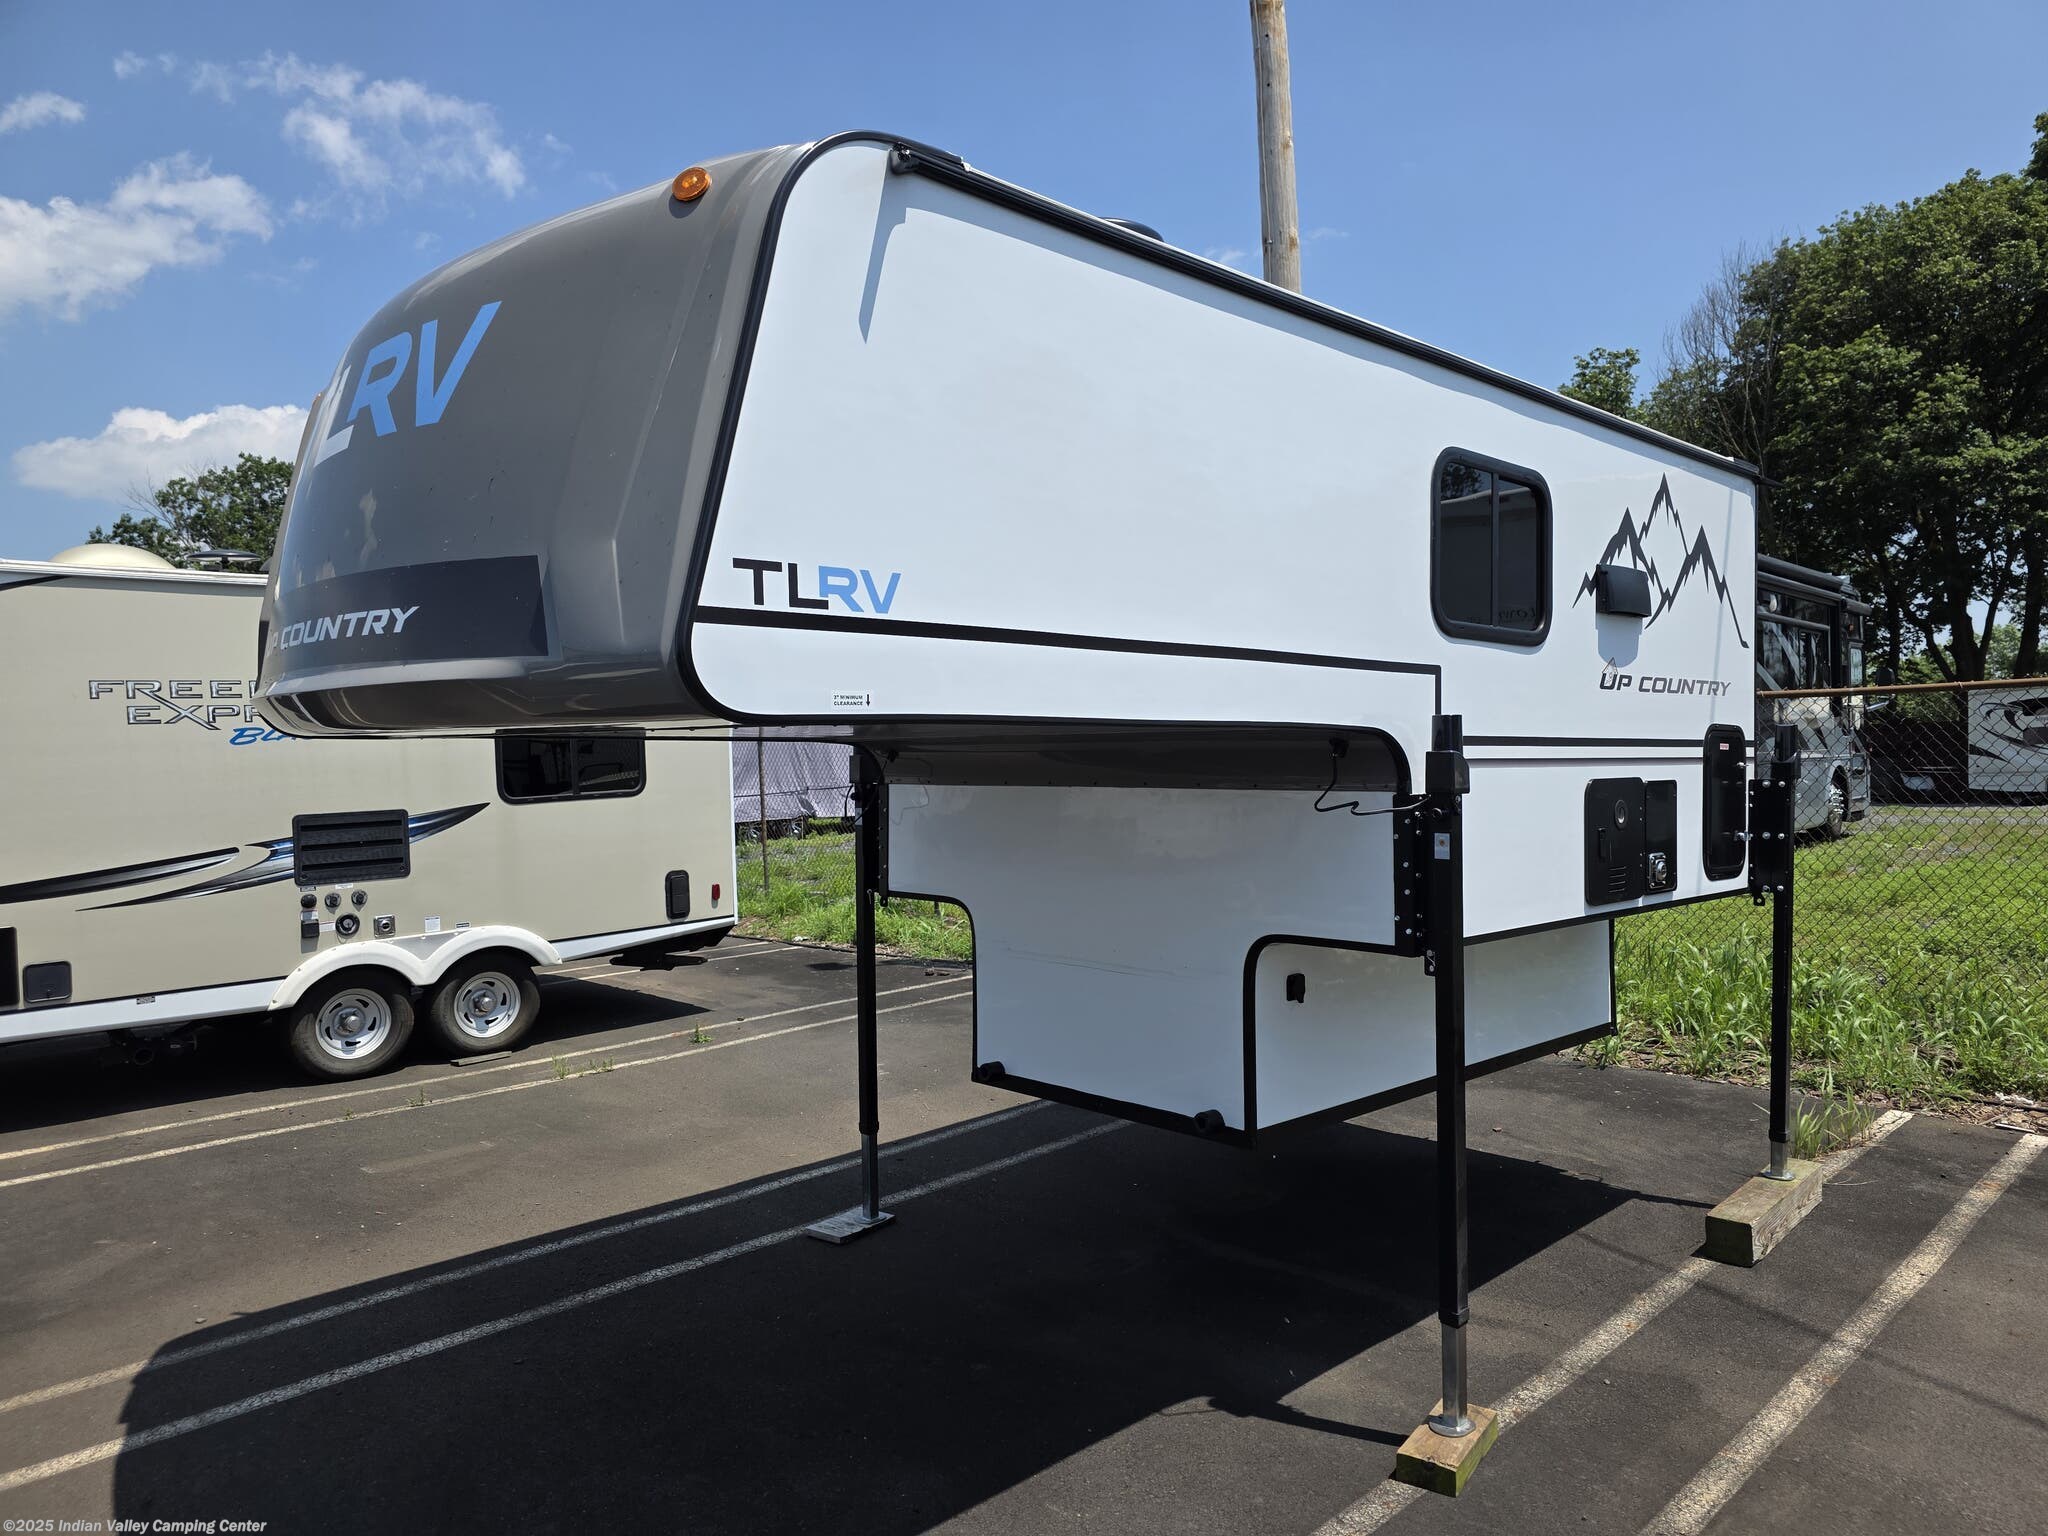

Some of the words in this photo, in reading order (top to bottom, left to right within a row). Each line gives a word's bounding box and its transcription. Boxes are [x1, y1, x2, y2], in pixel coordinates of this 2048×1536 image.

[732, 557, 901, 614] TLRV
[280, 606, 420, 650] COUNTRY
[88, 679, 257, 700] FREE
[1599, 672, 1632, 691] UP
[1638, 676, 1732, 697] COUNTRY
